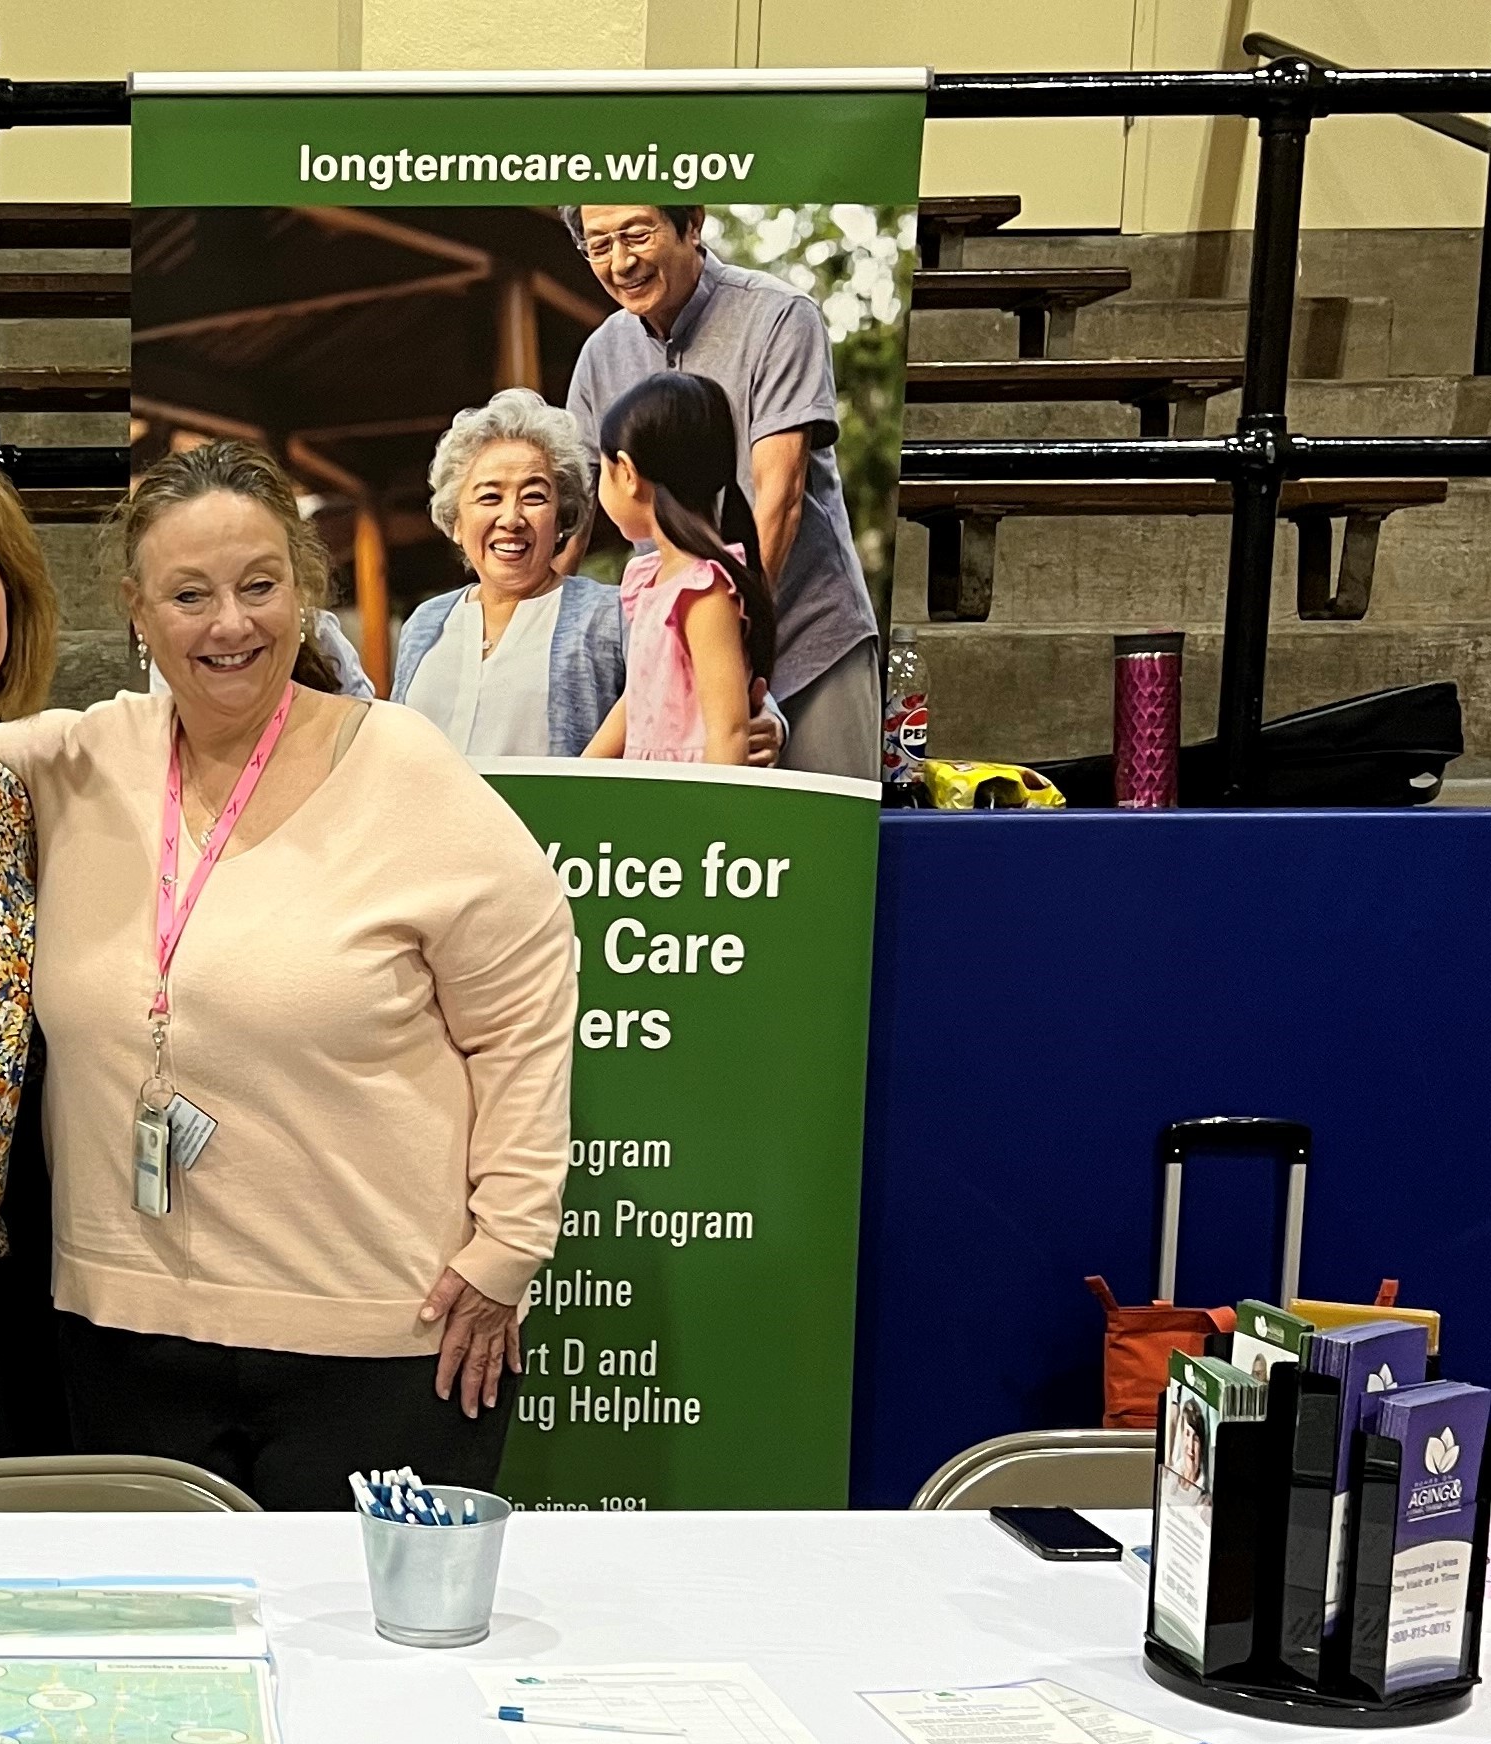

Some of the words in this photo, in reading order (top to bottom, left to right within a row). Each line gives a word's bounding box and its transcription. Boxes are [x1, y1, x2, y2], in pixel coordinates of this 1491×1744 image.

[299, 143, 756, 191] longtermcare.wi.gov
[701, 841, 790, 898] for
[604, 917, 746, 975] Care
[568, 1139, 671, 1177] ogram
[615, 1200, 754, 1248] Program
[528, 1269, 632, 1315] elpline
[524, 1343, 550, 1375] rt
[563, 1338, 585, 1375] D
[598, 1340, 658, 1377] and
[518, 1395, 556, 1431] ug
[570, 1386, 702, 1432] Helpline
